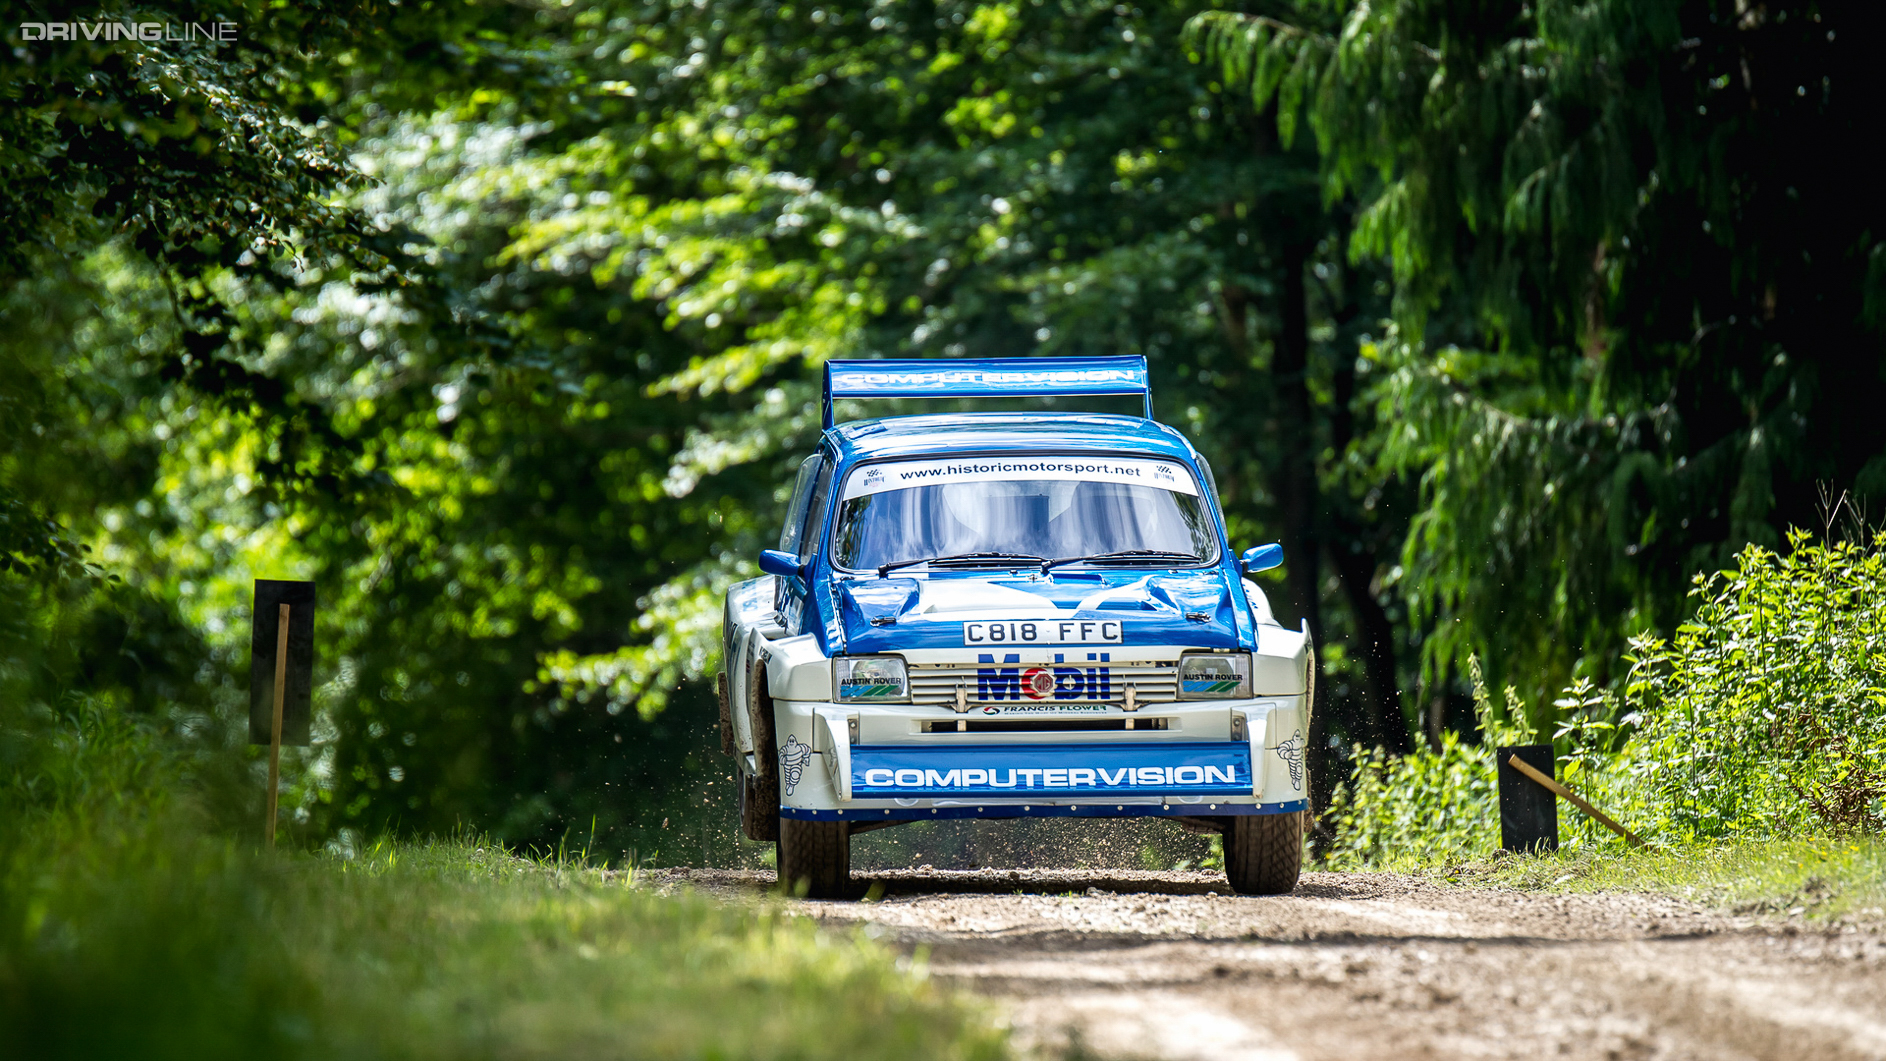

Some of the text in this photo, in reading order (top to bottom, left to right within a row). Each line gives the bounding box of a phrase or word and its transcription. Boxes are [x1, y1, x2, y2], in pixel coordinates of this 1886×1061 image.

[841, 369, 1135, 384] COMPUTERVISION
[900, 463, 1141, 480] www.historicmotorsport.net
[967, 621, 1119, 642] C818 FFC
[841, 677, 901, 685] AUSTIN ROVER
[1035, 675, 1052, 691] MG
[865, 765, 1236, 787] COMPUTERVISION
